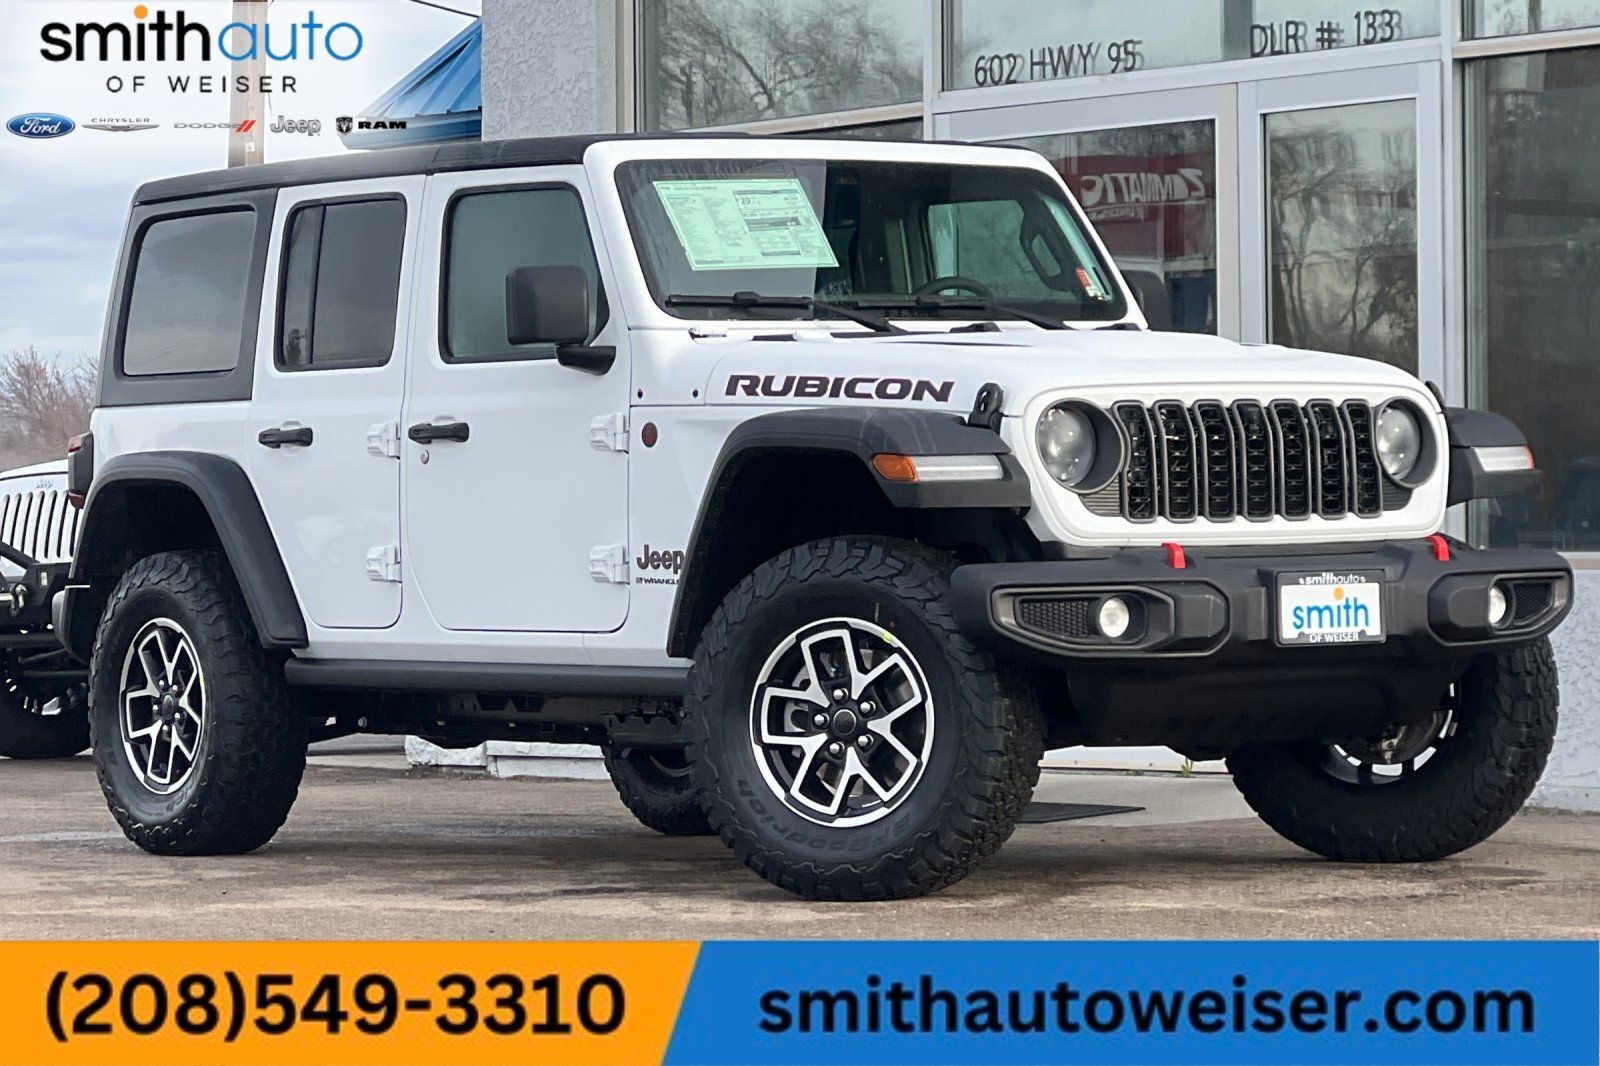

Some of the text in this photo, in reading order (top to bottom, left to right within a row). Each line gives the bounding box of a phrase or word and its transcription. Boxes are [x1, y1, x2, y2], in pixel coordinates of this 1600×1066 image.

[1250, 20, 1301, 58] DLR
[1354, 9, 1394, 46] 133
[974, 39, 1136, 87] 602 HWY 95
[724, 374, 956, 403] RUBICON
[636, 544, 685, 575] Jeep
[1305, 573, 1360, 585] smithauto
[1292, 587, 1370, 630] smith
[1309, 632, 1359, 643] OF WEISER
